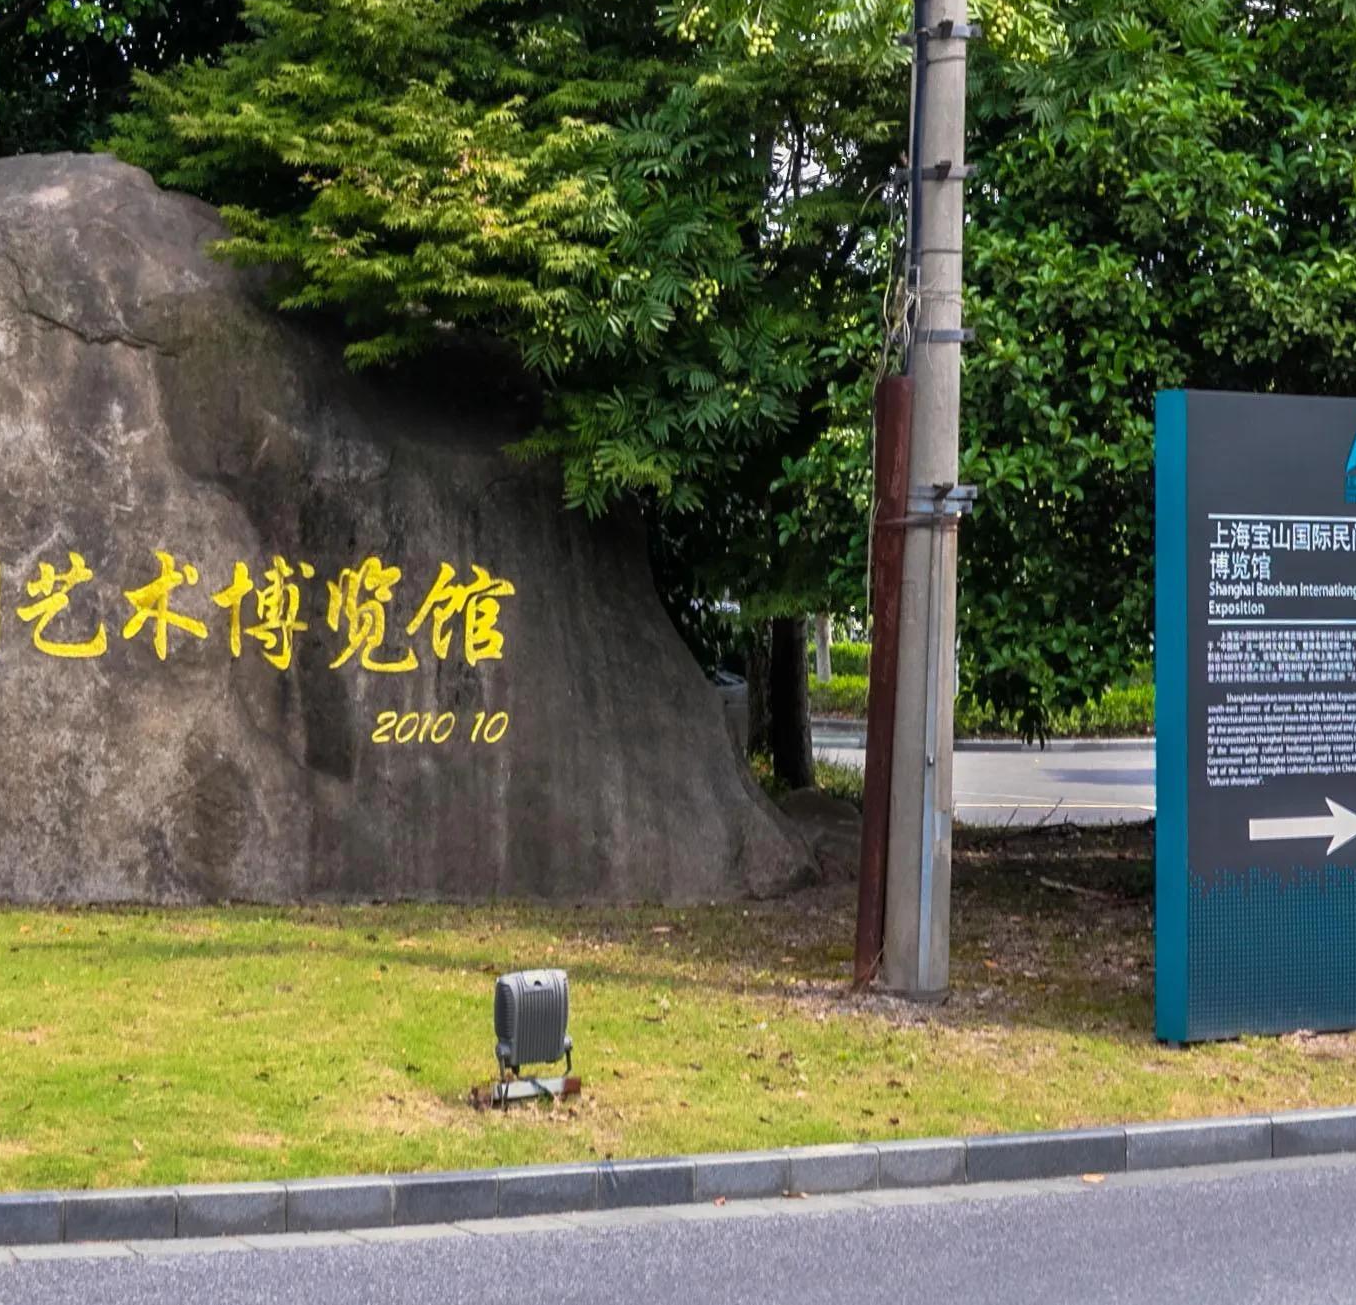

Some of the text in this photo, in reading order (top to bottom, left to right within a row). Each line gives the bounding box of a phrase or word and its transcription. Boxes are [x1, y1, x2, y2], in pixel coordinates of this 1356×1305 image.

[1210, 552, 1271, 580] 博览馆
[1209, 582, 1255, 599] Shanghai
[1256, 582, 1298, 597] Baoshan
[1209, 600, 1265, 617] Exposition
[371, 711, 509, 745] 2010 10
